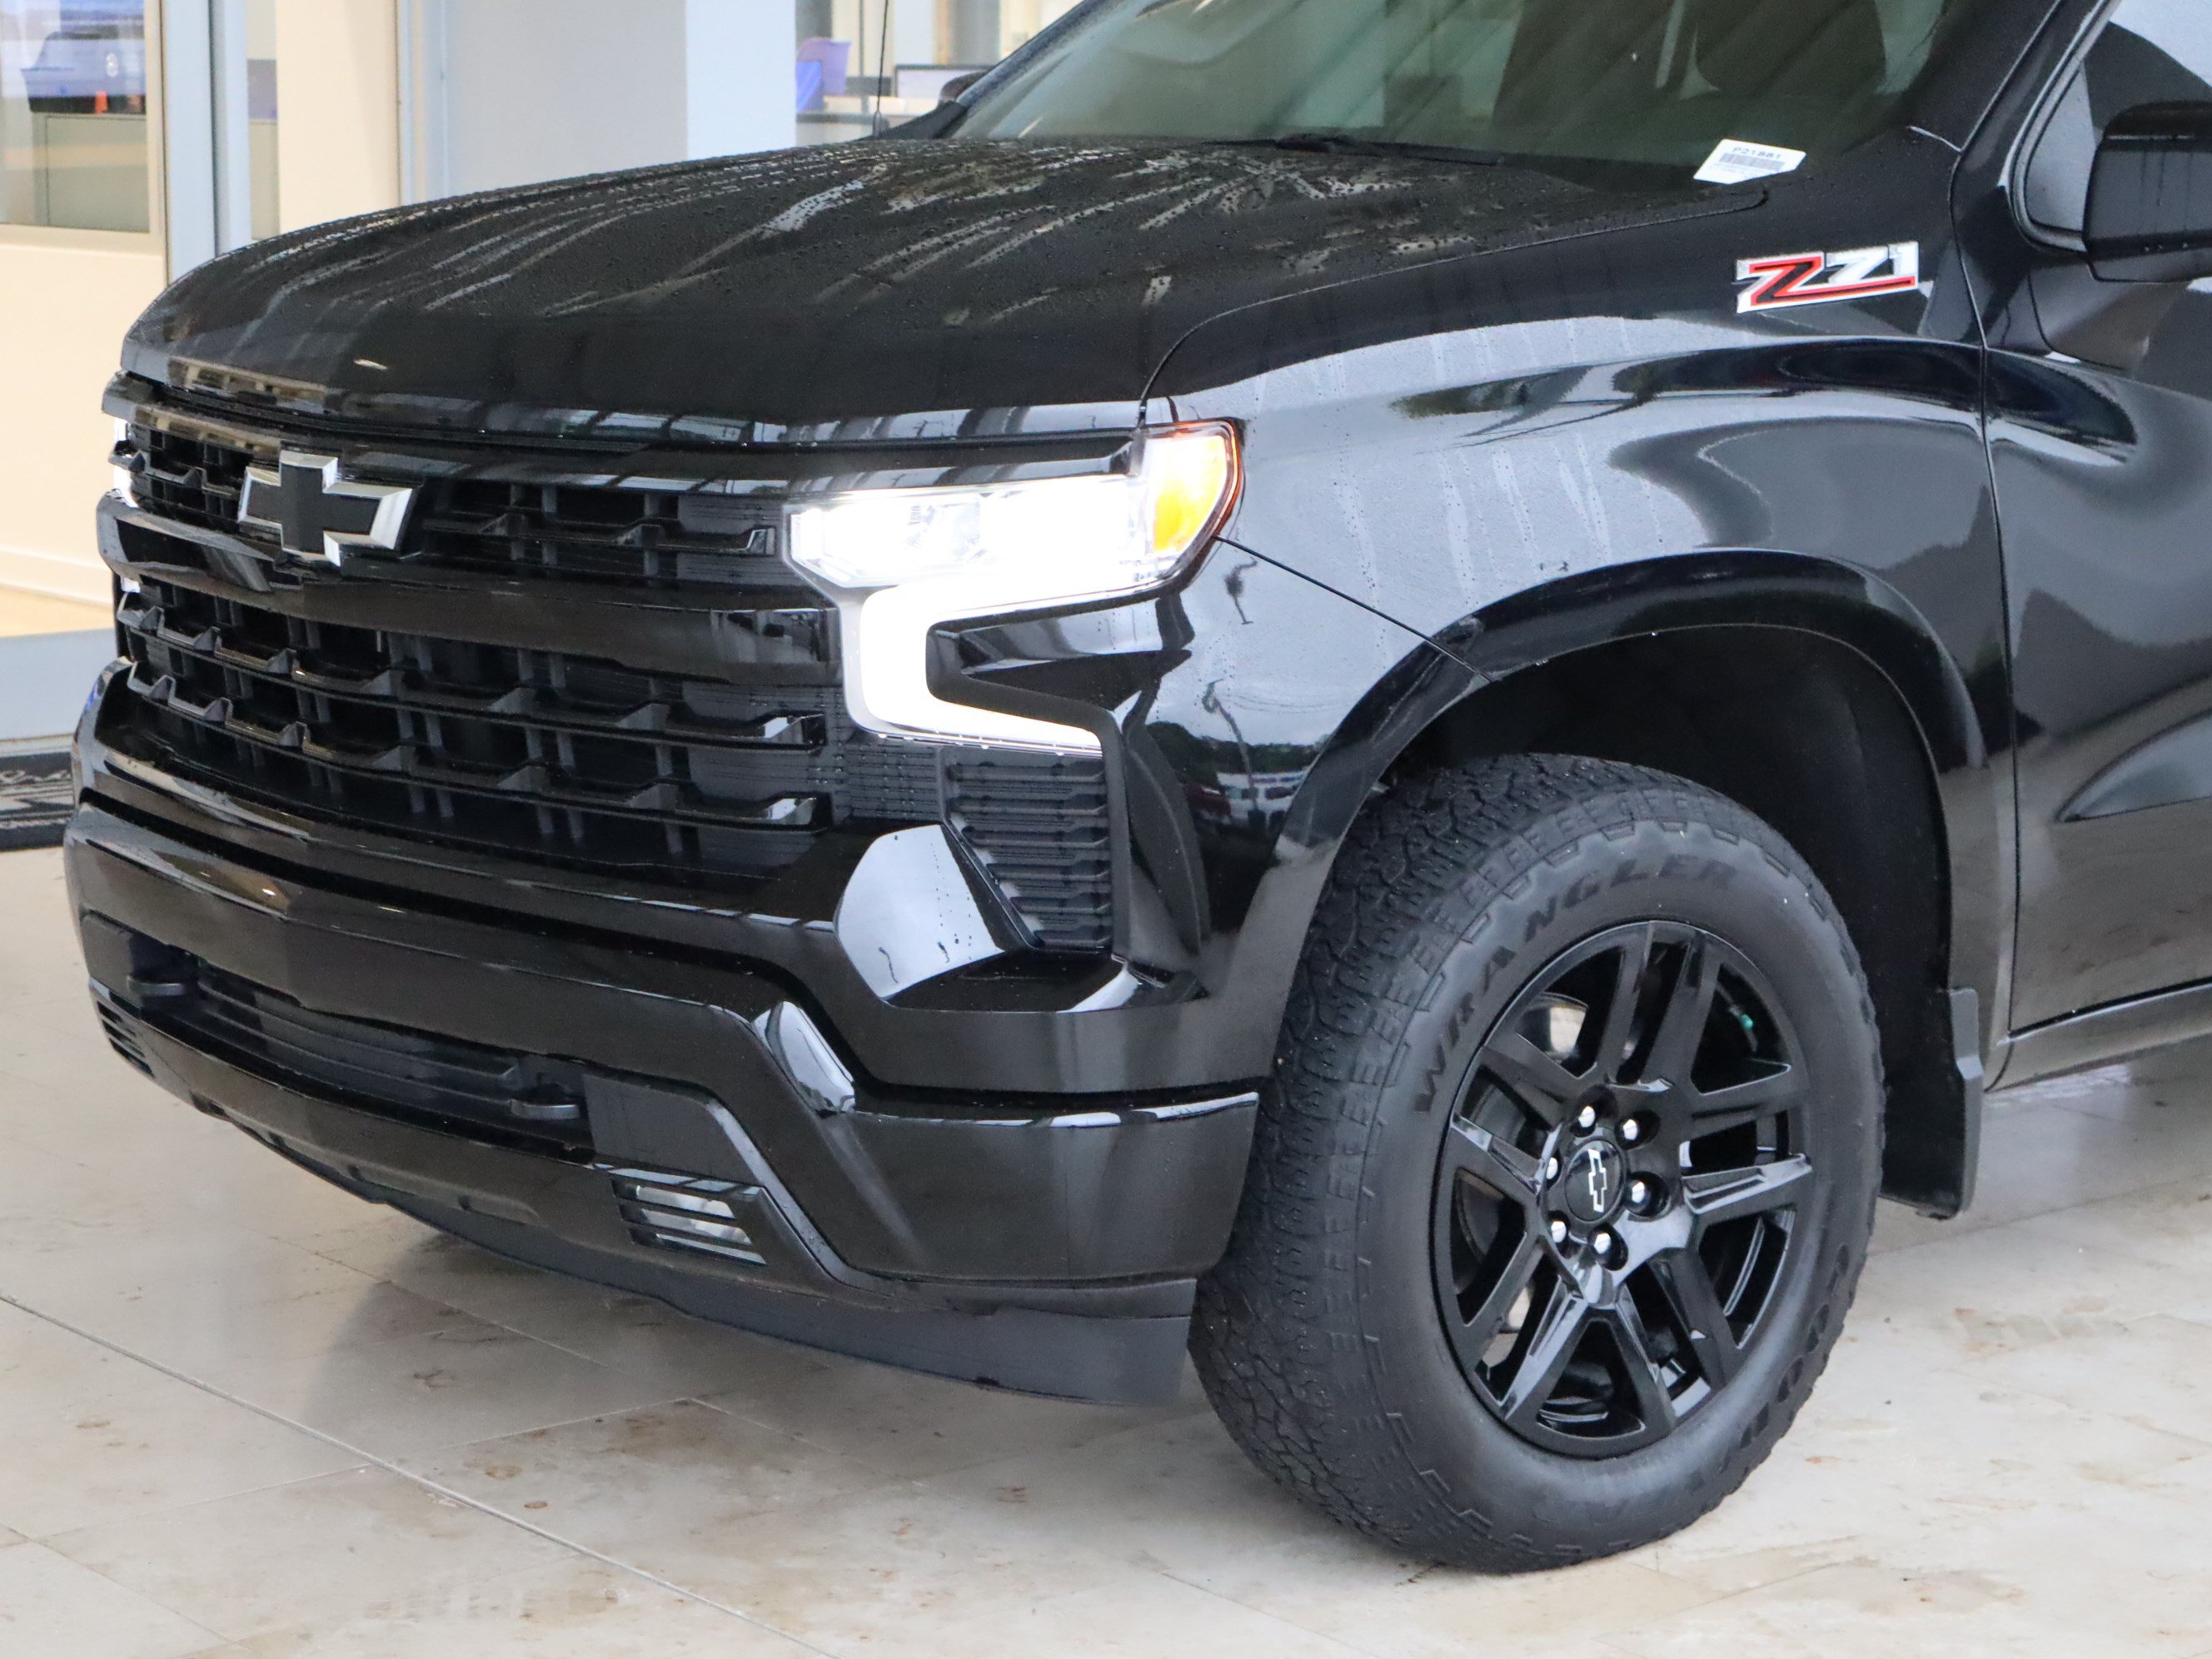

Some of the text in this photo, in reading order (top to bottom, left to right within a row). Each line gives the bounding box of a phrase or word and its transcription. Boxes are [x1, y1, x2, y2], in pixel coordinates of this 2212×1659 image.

[1732, 147, 1782, 160] P21881
[1735, 241, 1919, 314] Z71
[1412, 854, 1737, 1113] WRANGLER
